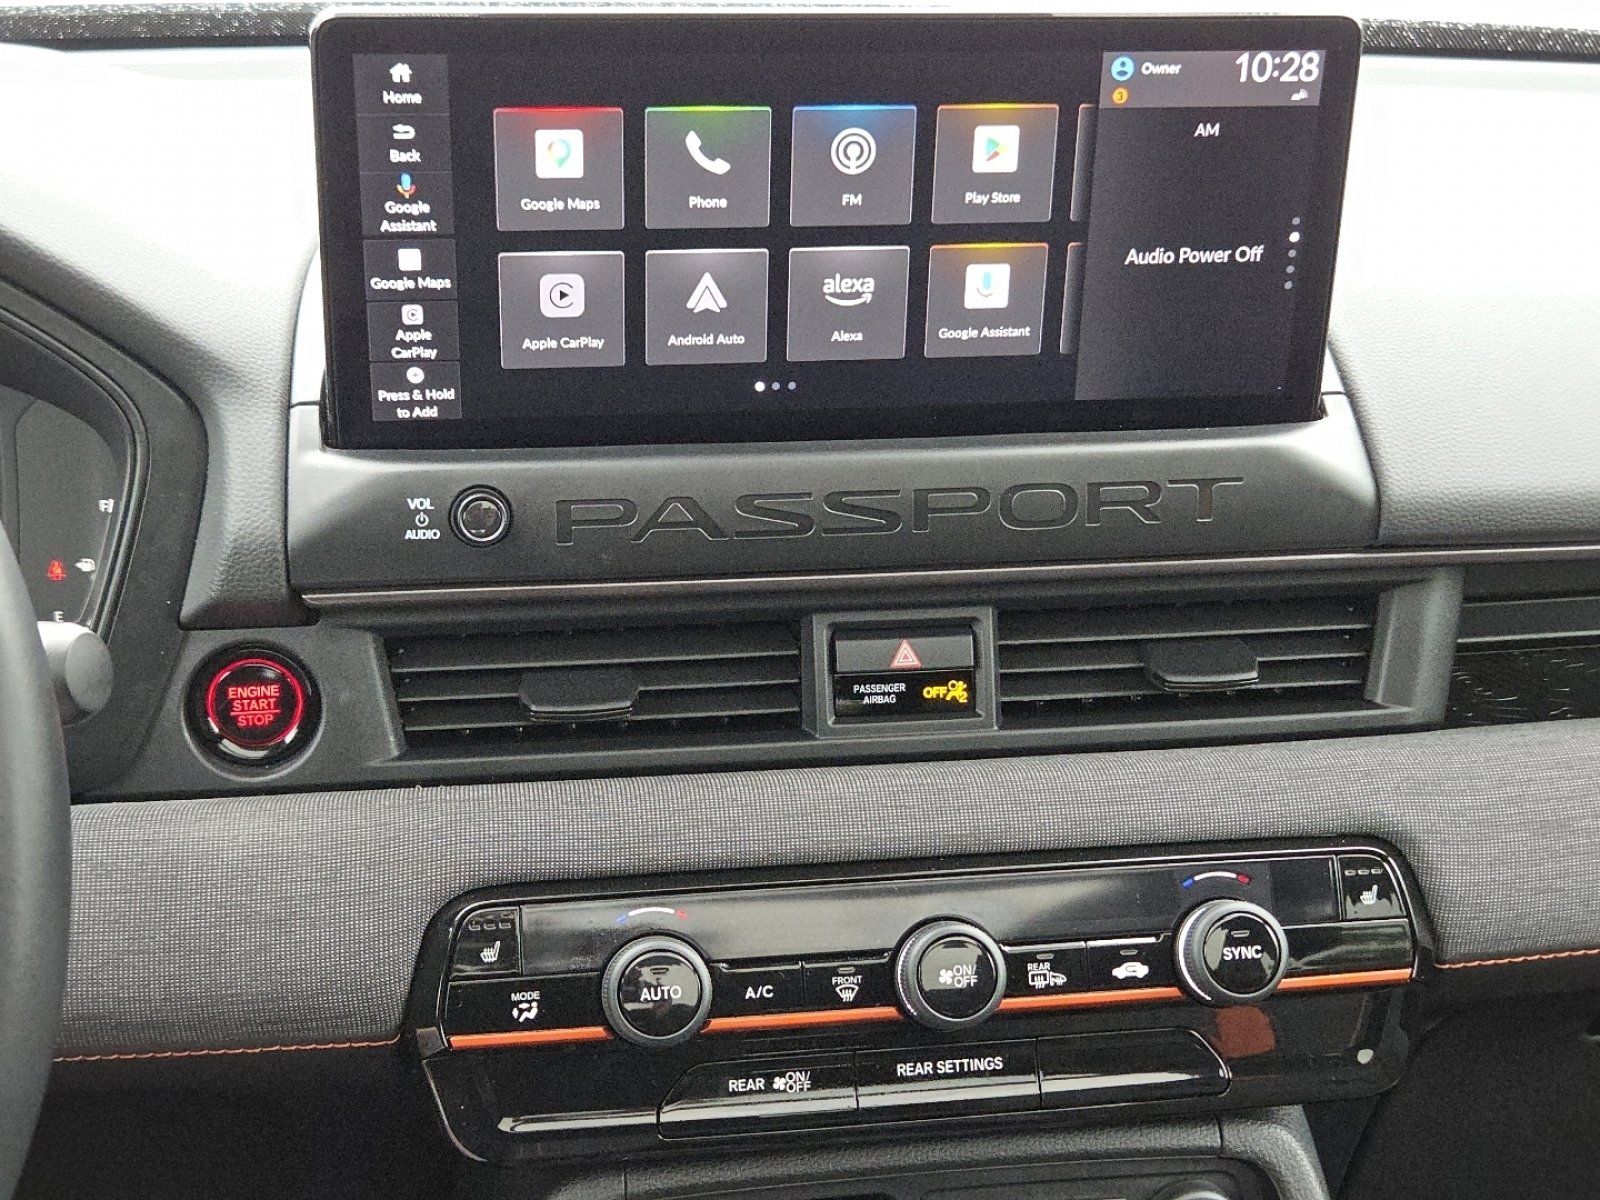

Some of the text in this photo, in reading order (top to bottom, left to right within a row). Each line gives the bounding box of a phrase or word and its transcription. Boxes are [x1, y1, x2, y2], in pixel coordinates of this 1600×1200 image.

[1141, 62, 1182, 75] Owner
[1235, 51, 1320, 83] 10:28
[382, 90, 422, 105] Home
[1194, 123, 1220, 138] AM
[390, 149, 421, 163] Back
[520, 197, 600, 213] Google Maps
[689, 196, 728, 209] Phone
[842, 194, 863, 207] FM
[965, 192, 1021, 205] Play Store
[384, 201, 430, 215] Google
[380, 219, 437, 233] Assistant
[1125, 245, 1265, 265] Audio Power Off
[370, 276, 451, 290] Google Maps
[822, 272, 875, 294] alexa
[395, 328, 432, 342] Apple
[668, 333, 745, 346] Android Auto
[831, 329, 863, 343] Alexa
[938, 326, 1031, 340] Google Assistant
[522, 335, 604, 350] Apple CarPlay
[391, 346, 437, 360] CarPlay
[378, 388, 455, 402] Press & Hold
[397, 406, 438, 418] to Add
[407, 498, 434, 511] VOL
[556, 477, 1244, 546] PASSPORT
[404, 528, 440, 541] AUDIO
[228, 684, 280, 699] ENGINE
[853, 682, 906, 694] PASSENGER
[923, 686, 947, 699] OFF
[232, 698, 276, 712] START
[863, 694, 897, 704] AIRBAG
[237, 713, 274, 727] STOP
[1222, 944, 1262, 961] SYNC
[953, 964, 977, 977] ON/
[1027, 962, 1050, 972] REAR
[832, 975, 863, 986] FRONT
[953, 975, 978, 988] OFF
[511, 991, 540, 1002] MODE
[640, 985, 682, 1002] AUTO
[745, 985, 774, 999] A/C
[896, 1057, 1003, 1077] REAR SETTINGS
[728, 1070, 811, 1093] REAR ON/
[786, 1081, 811, 1093] OFF
